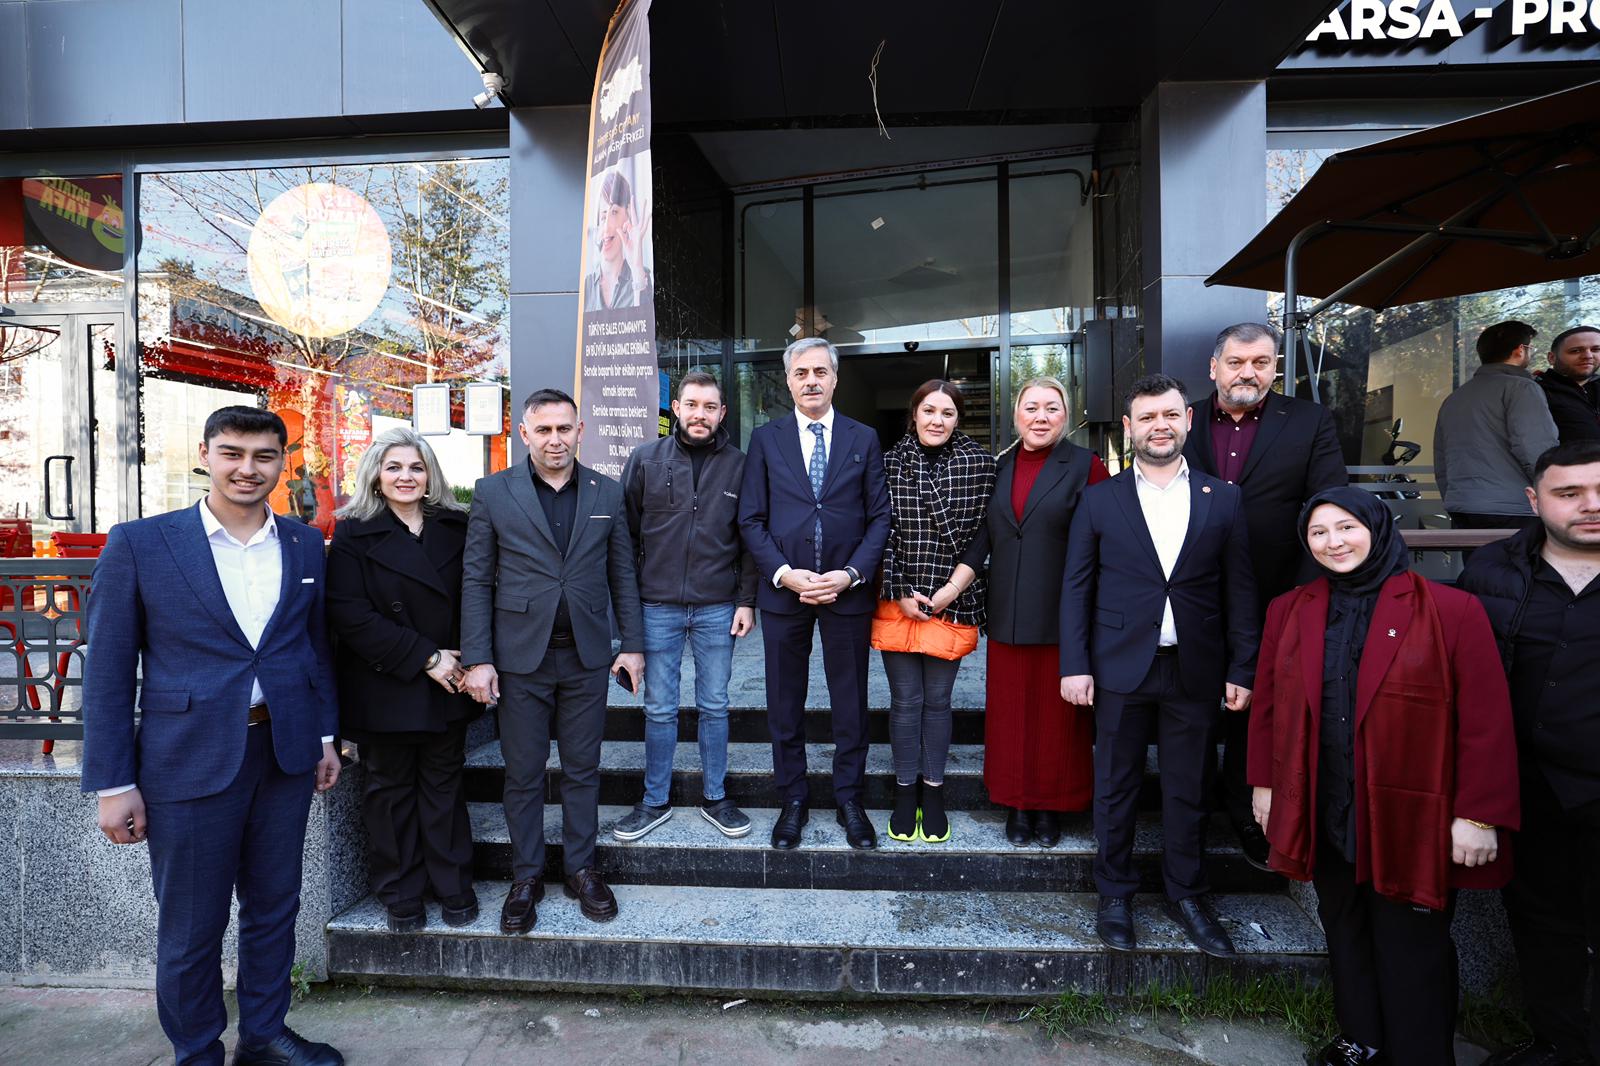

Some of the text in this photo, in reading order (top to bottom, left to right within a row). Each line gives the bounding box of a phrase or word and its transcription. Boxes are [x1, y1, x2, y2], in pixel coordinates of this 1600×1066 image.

[1304, 0, 1464, 41] ARSA
[1511, 0, 1600, 36] PR
[591, 341, 607, 357] BÜYÜK
[622, 363, 636, 376] ekibin
[602, 384, 617, 397] olmak
[598, 423, 618, 437] HAFTADA
[621, 423, 633, 438] GÜN
[633, 423, 644, 439] TATİL
[608, 444, 619, 457] BOL
